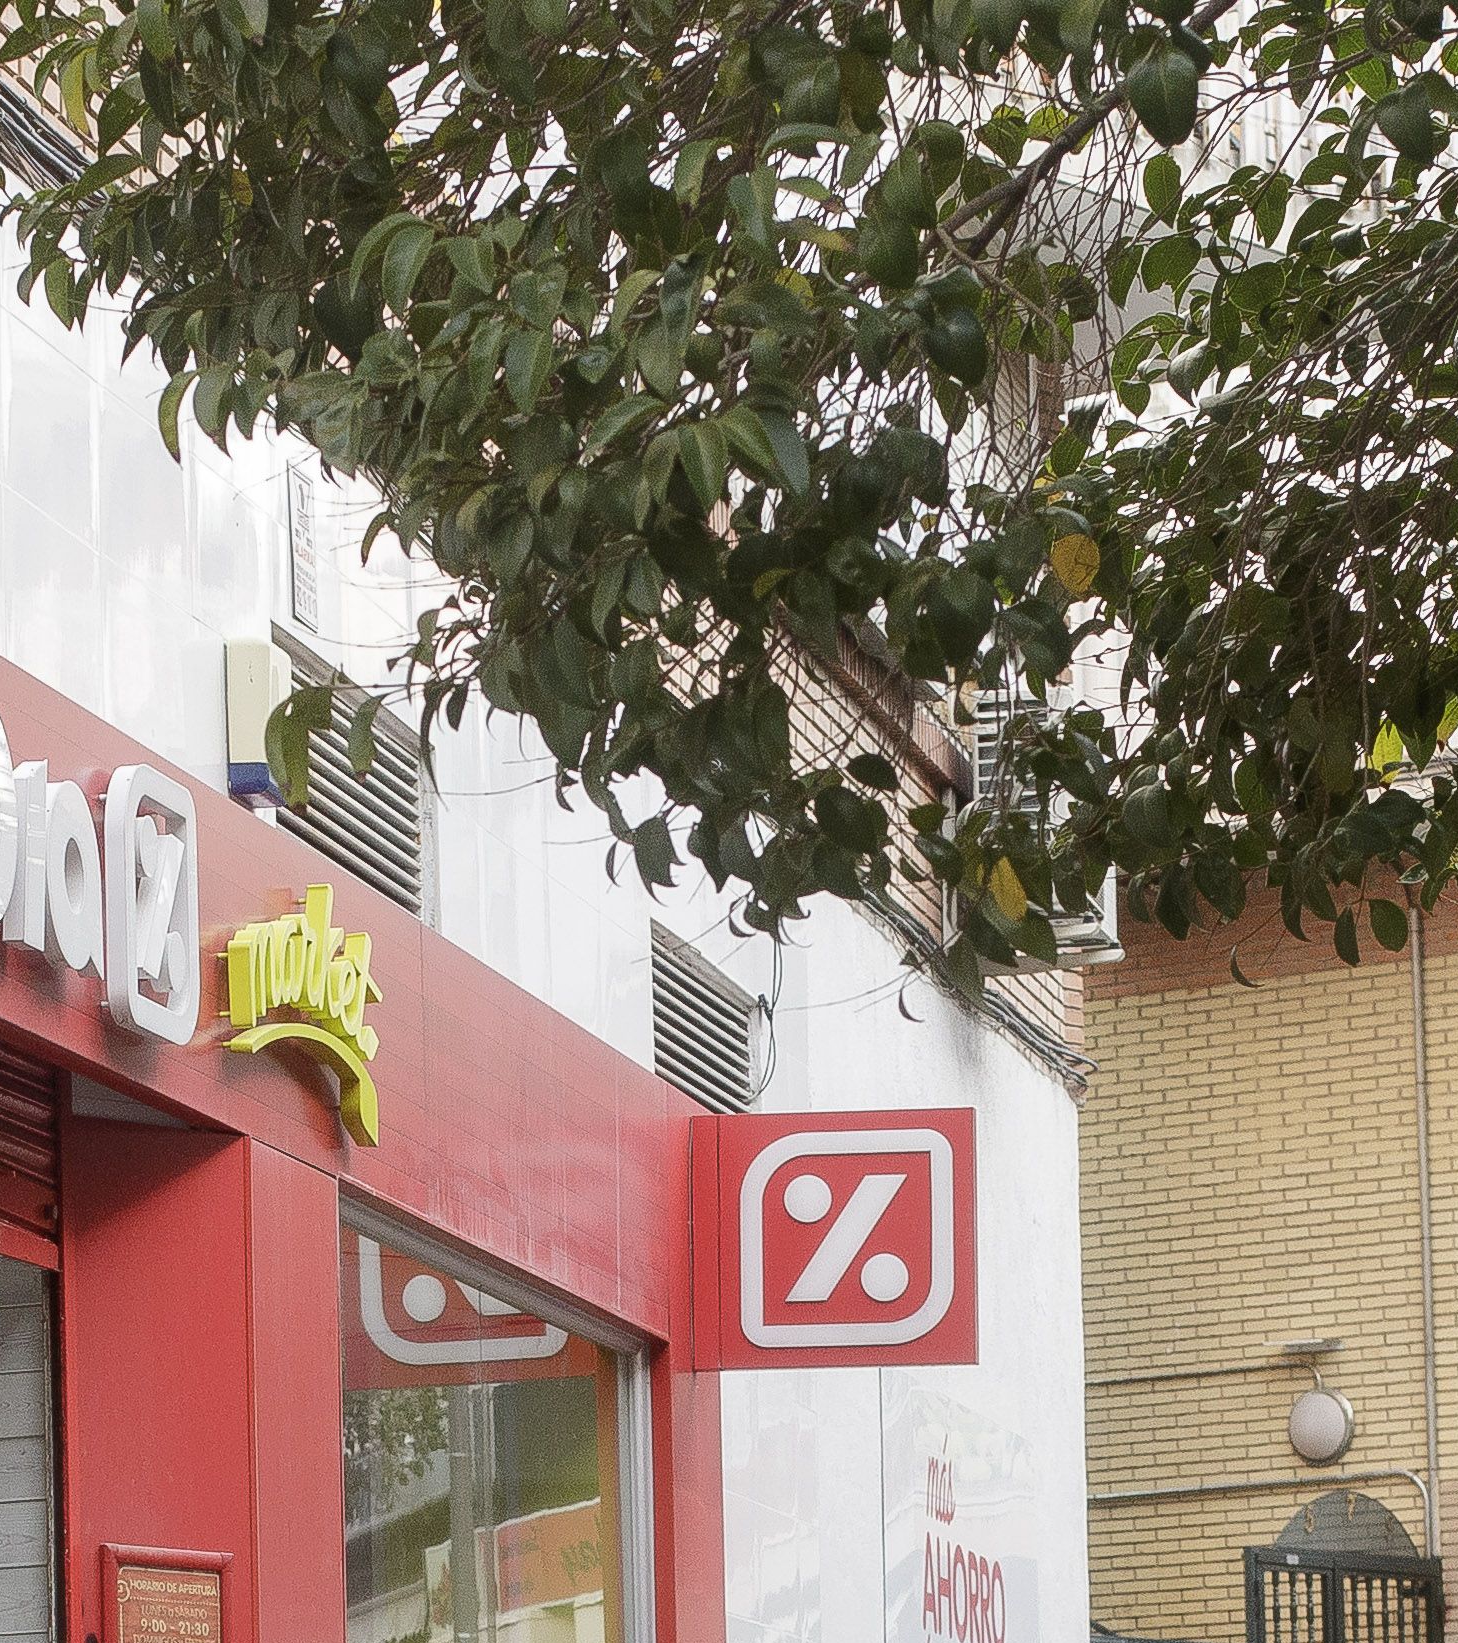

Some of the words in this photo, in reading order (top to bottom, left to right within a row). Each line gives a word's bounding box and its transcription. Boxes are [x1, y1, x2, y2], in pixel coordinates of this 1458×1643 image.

[228, 883, 383, 1061] market
[927, 1434, 956, 1525] más
[130, 1579, 165, 1591] HORARIO
[167, 1582, 177, 1593] DE
[178, 1583, 217, 1597] APERTURA
[140, 1618, 167, 1633] 9:00
[178, 1621, 210, 1637] 21:30
